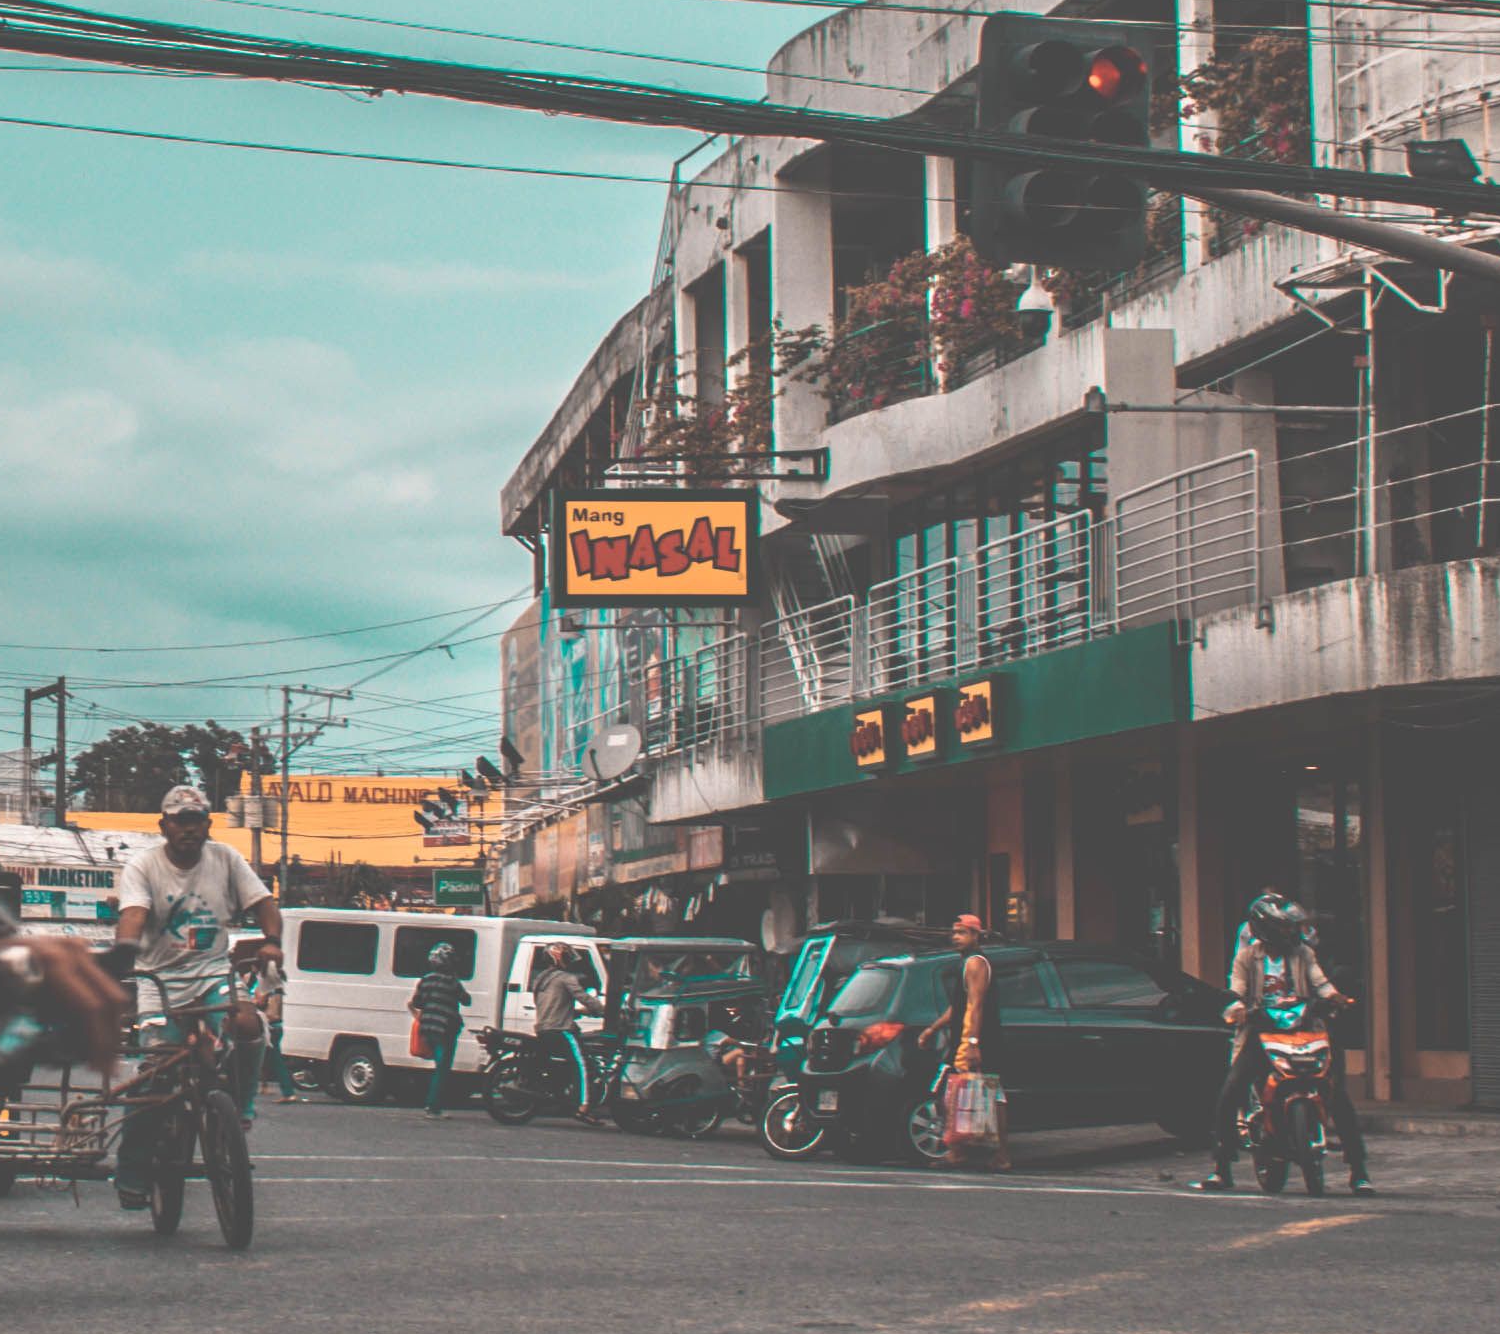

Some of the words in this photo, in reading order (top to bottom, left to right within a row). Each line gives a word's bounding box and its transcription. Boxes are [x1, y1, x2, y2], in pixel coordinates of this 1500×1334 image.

[572, 508, 625, 526] Mang
[570, 516, 741, 582] INASAL
[39, 867, 114, 888] MARKETING
